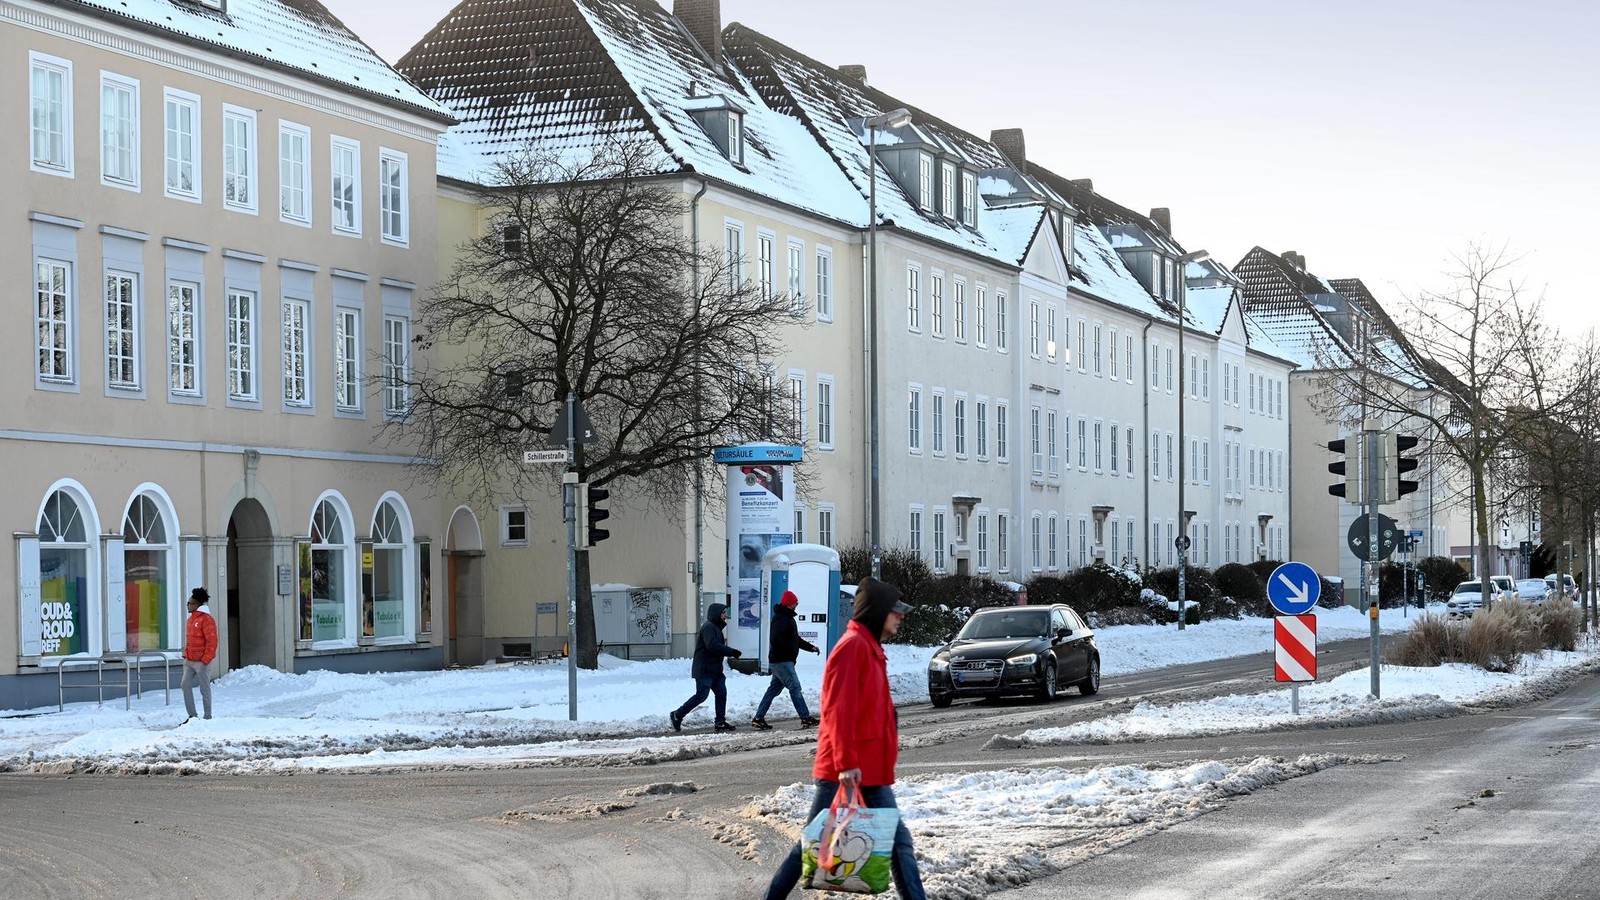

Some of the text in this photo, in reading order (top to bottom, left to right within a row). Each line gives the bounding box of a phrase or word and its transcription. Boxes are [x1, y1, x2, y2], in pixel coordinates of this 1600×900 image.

[527, 451, 565, 461] Schillerstraße
[317, 614, 334, 624] Tabula
[377, 611, 393, 621] Tabula
[41, 620, 75, 639] ROUD
